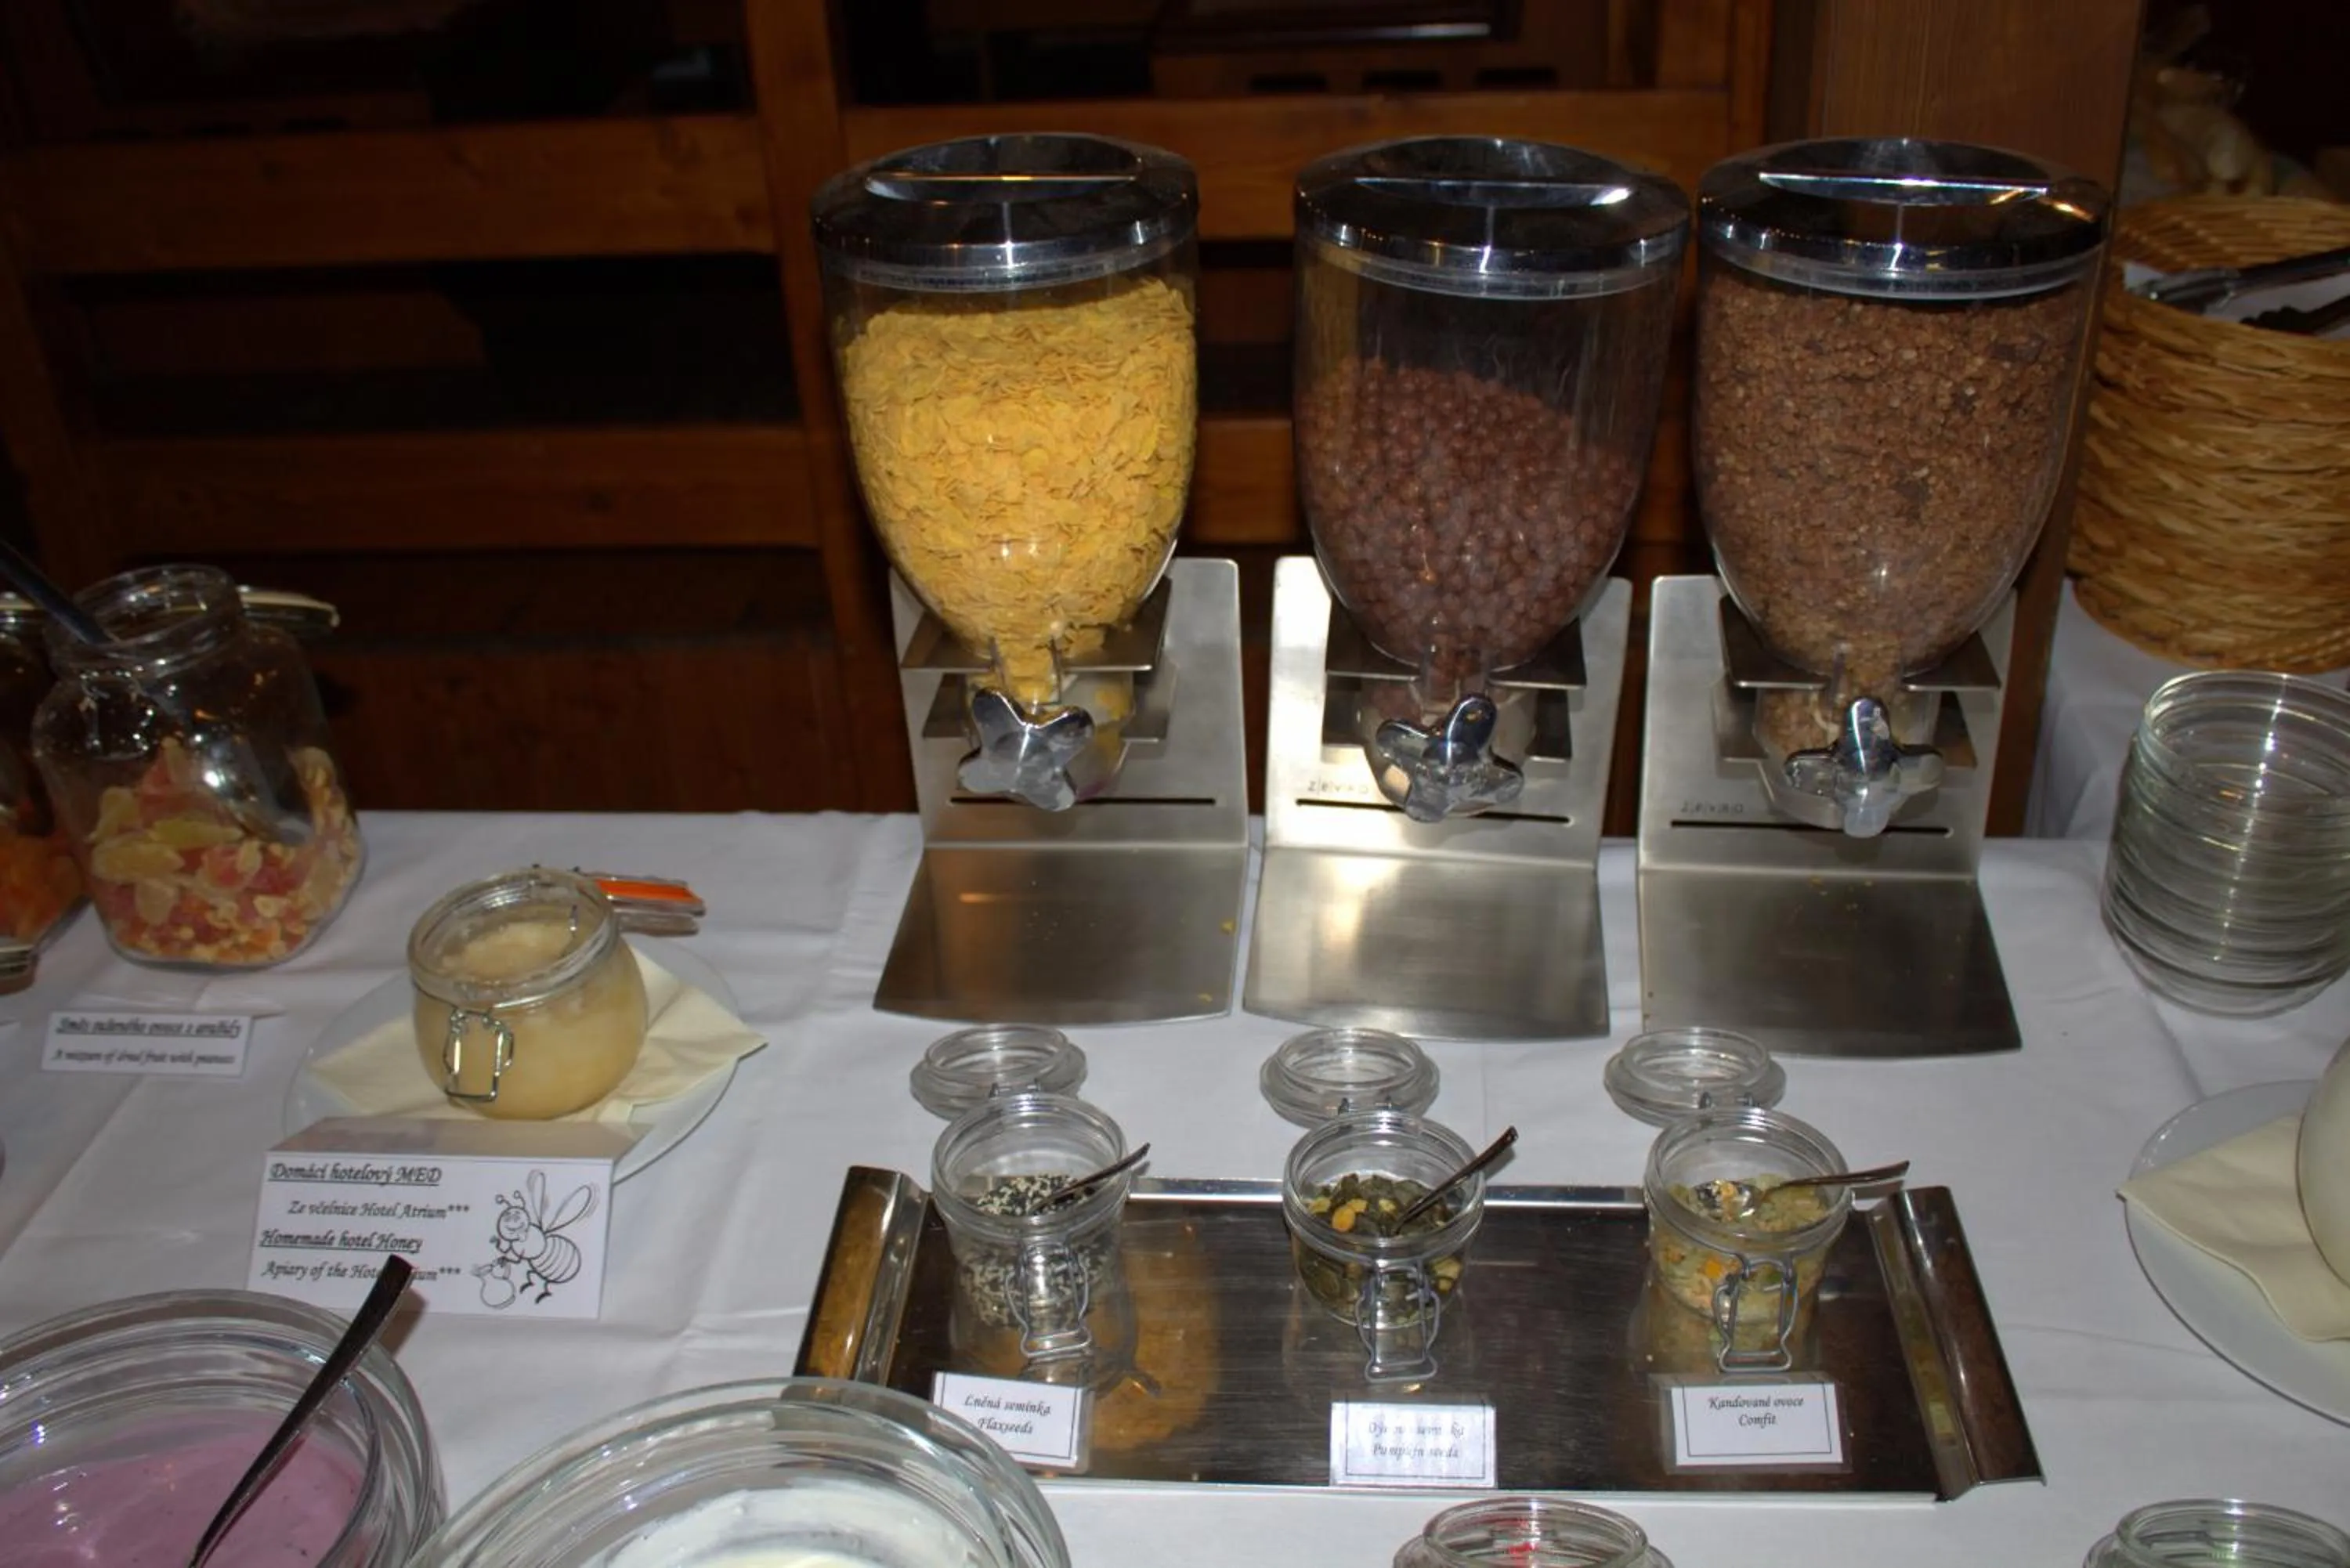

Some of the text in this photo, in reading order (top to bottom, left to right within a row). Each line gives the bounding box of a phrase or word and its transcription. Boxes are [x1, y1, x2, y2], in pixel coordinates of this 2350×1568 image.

[330, 1162, 395, 1186] hotelový
[395, 1165, 443, 1185] MED
[287, 1200, 306, 1215] Ze
[308, 1200, 358, 1216] včelnice
[358, 1202, 398, 1217] Hotel
[259, 1228, 424, 1254] Homemade hotel Honey
[261, 1260, 308, 1280] Apiary
[309, 1261, 327, 1282] of
[327, 1262, 346, 1277] the
[349, 1263, 381, 1280] Hote
[964, 1394, 1052, 1417] Lněná semínka
[1708, 1396, 1805, 1411] Kandované ovoce
[978, 1416, 1033, 1435] Flaxseeds
[1738, 1412, 1777, 1429] Comfit
